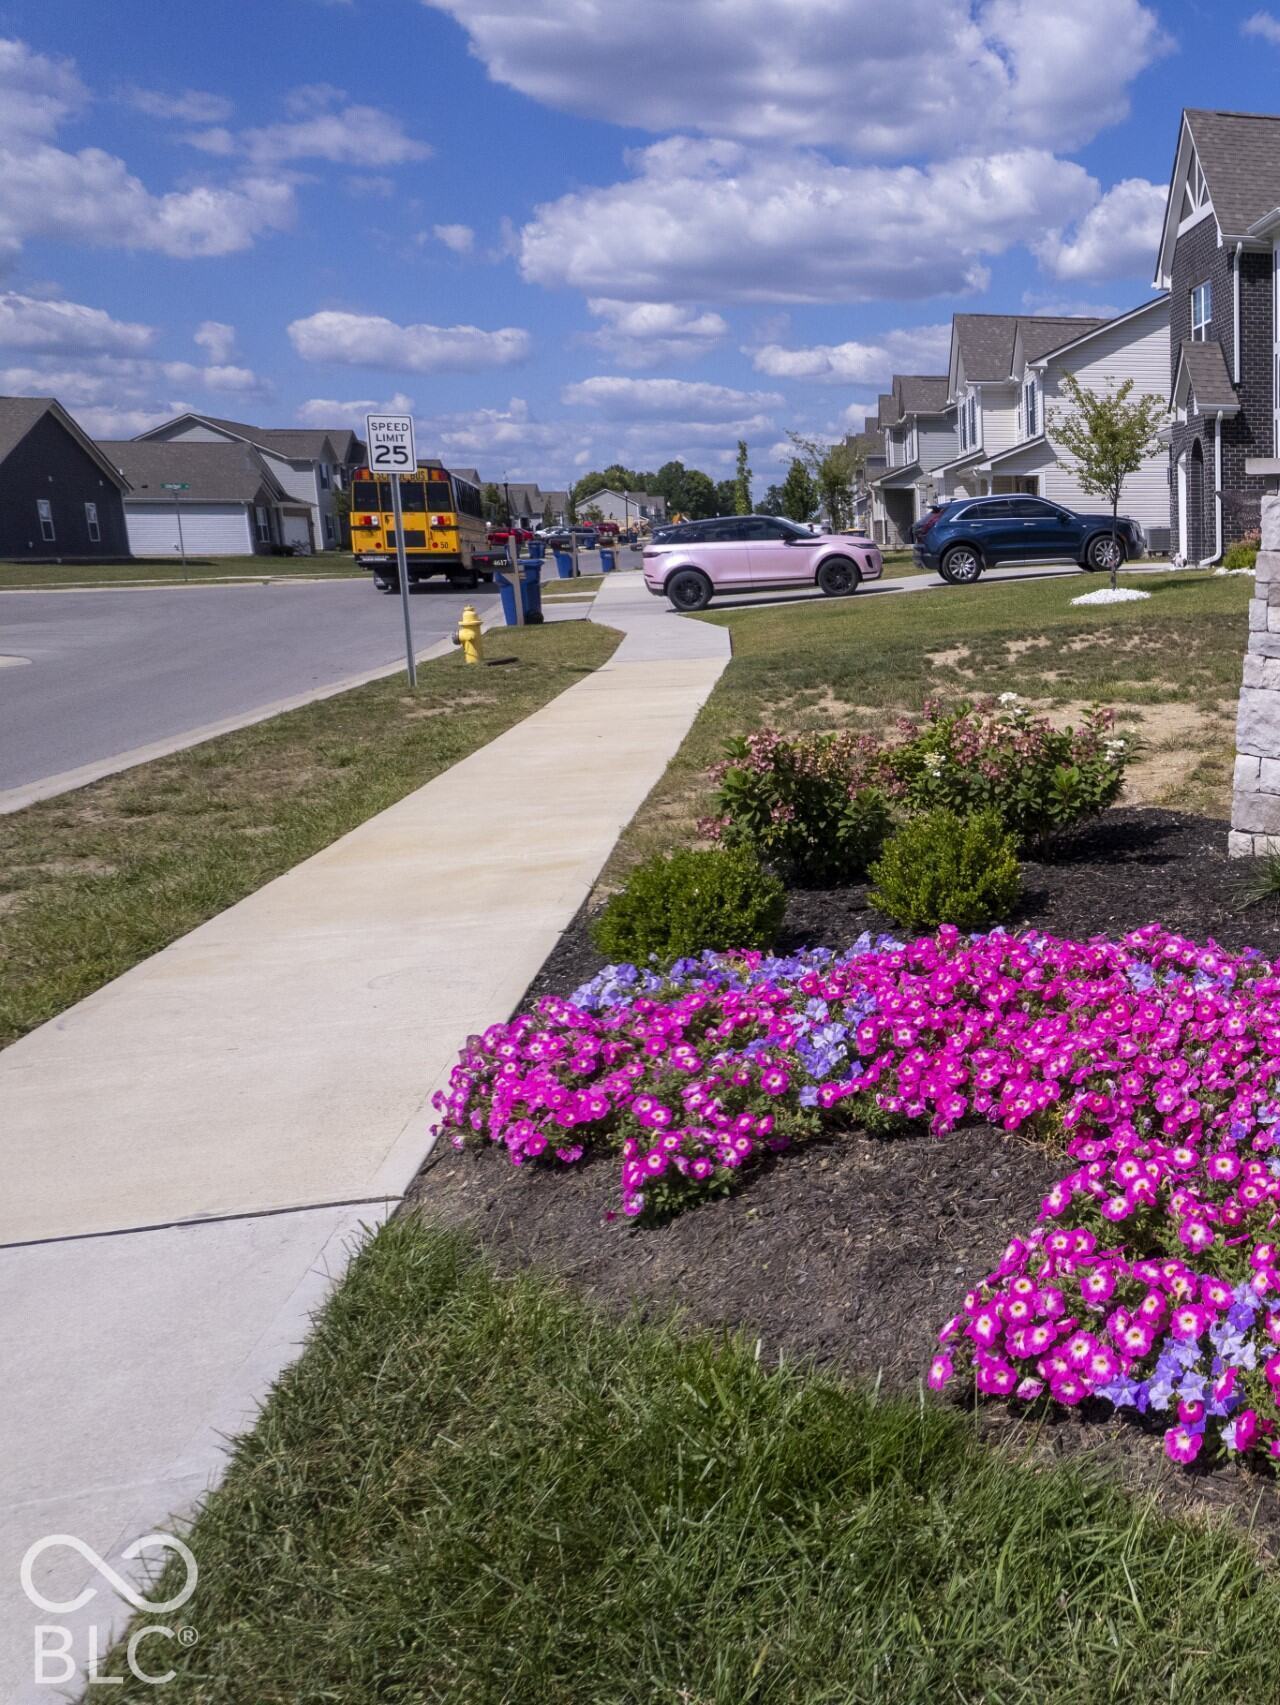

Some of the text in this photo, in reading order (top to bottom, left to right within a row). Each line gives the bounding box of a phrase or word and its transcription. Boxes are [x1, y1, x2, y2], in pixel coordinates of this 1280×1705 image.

[371, 422, 409, 431] SPEED
[376, 434, 405, 442] LIMIT
[375, 445, 409, 464] 25
